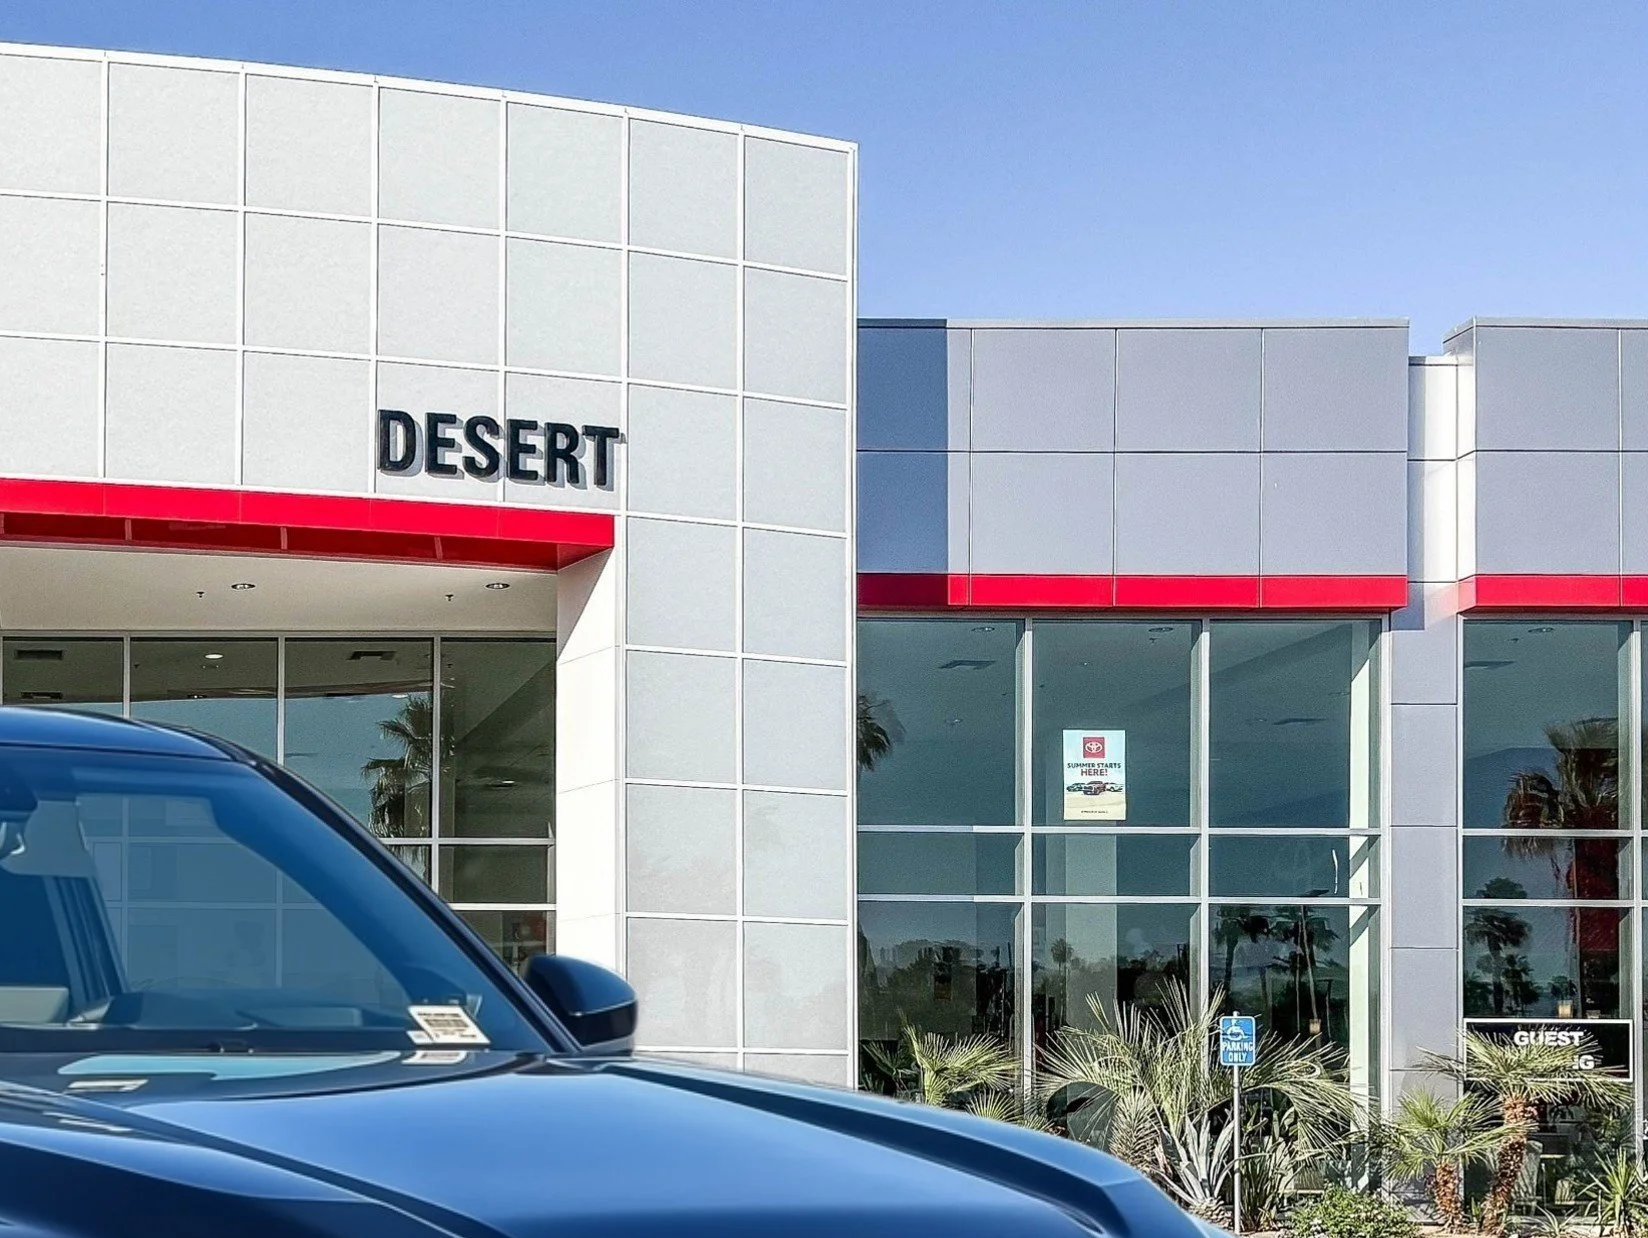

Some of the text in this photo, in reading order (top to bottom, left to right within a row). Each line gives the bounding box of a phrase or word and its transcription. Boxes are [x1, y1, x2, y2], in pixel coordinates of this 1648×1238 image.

[377, 409, 620, 487] DESERT
[1080, 768, 1108, 776] HERE!
[1513, 1030, 1584, 1047] GUEST
[1222, 1041, 1254, 1052] PARKING
[1228, 1051, 1248, 1062] ONLY
